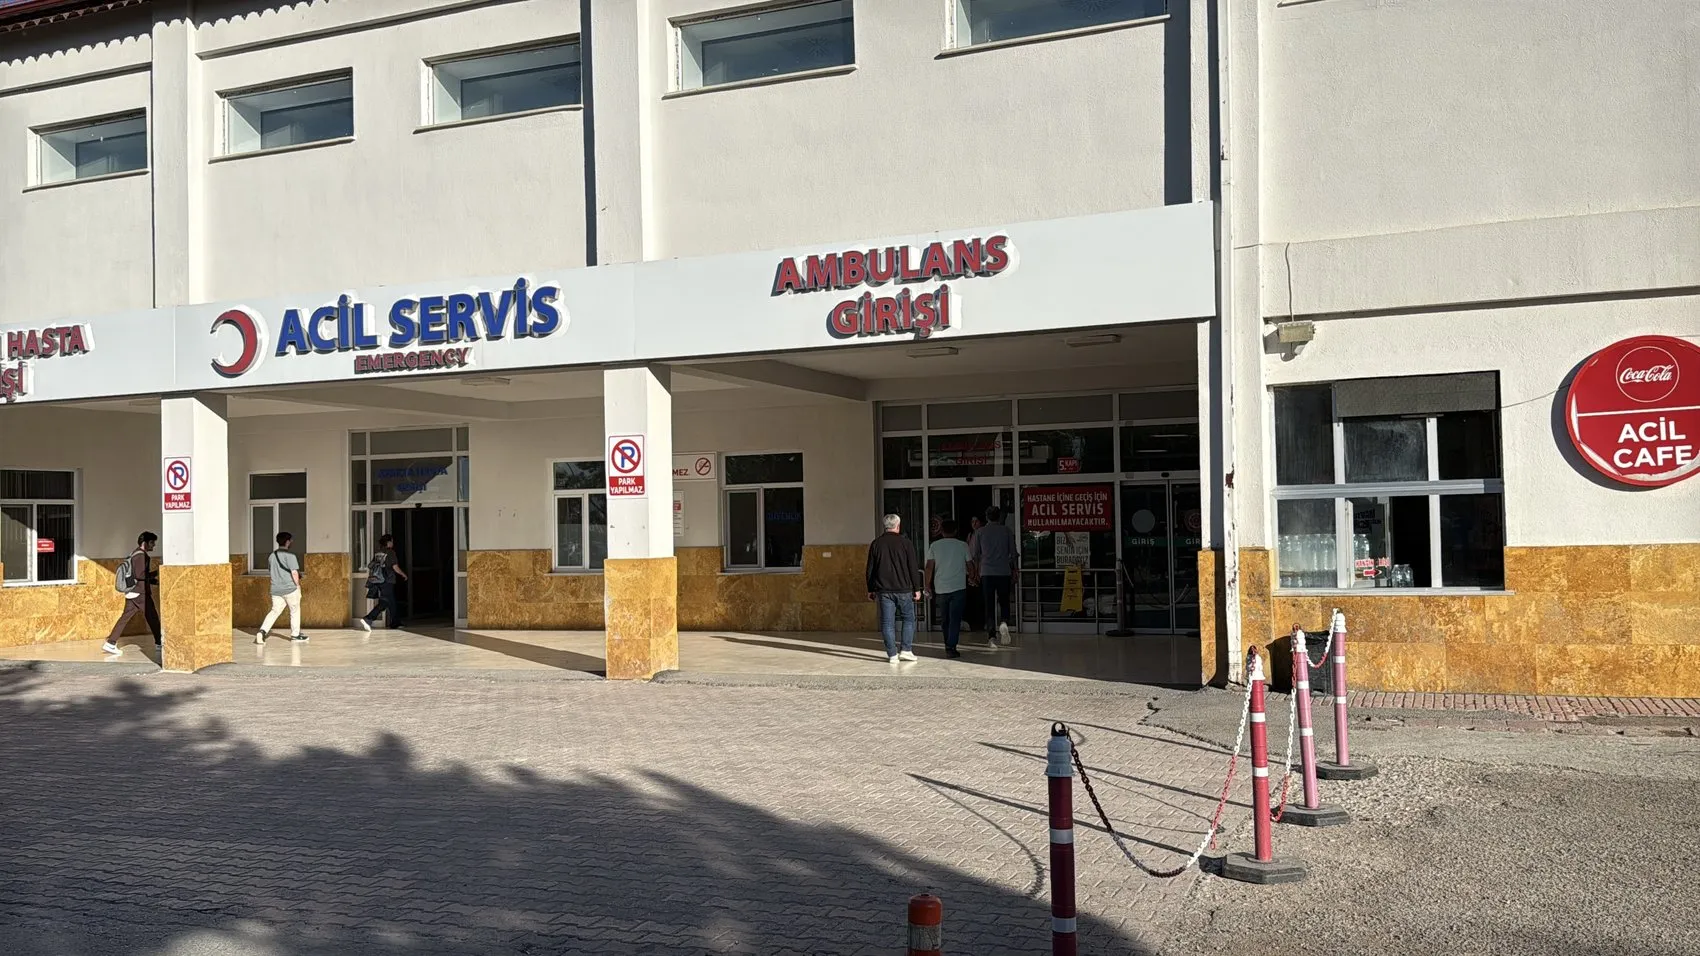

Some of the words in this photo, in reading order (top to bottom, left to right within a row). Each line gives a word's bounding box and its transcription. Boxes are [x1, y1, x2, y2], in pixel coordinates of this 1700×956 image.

[771, 235, 1008, 296] AMBULANS
[275, 294, 380, 356] ACİL
[388, 278, 560, 348] SERVİS
[827, 284, 950, 339] GİRİŞİ
[7, 325, 86, 360] HASTA
[354, 347, 471, 374] EMERGENCY
[0, 361, 24, 398] Şİ
[1619, 364, 1675, 384] Coca-Cola
[1617, 416, 1686, 443] ACİL
[1613, 445, 1693, 468] CAFE
[618, 477, 636, 486] PARK
[673, 468, 690, 476] MEZ
[171, 494, 185, 502] PARK
[1027, 494, 1055, 503] HASTANE
[1057, 492, 1073, 503] İÇİNE
[1031, 503, 1057, 516] ACİL
[1061, 502, 1104, 516] SERVİS
[1132, 537, 1155, 546] GİRİŞ
[1185, 537, 1200, 545] GİR
